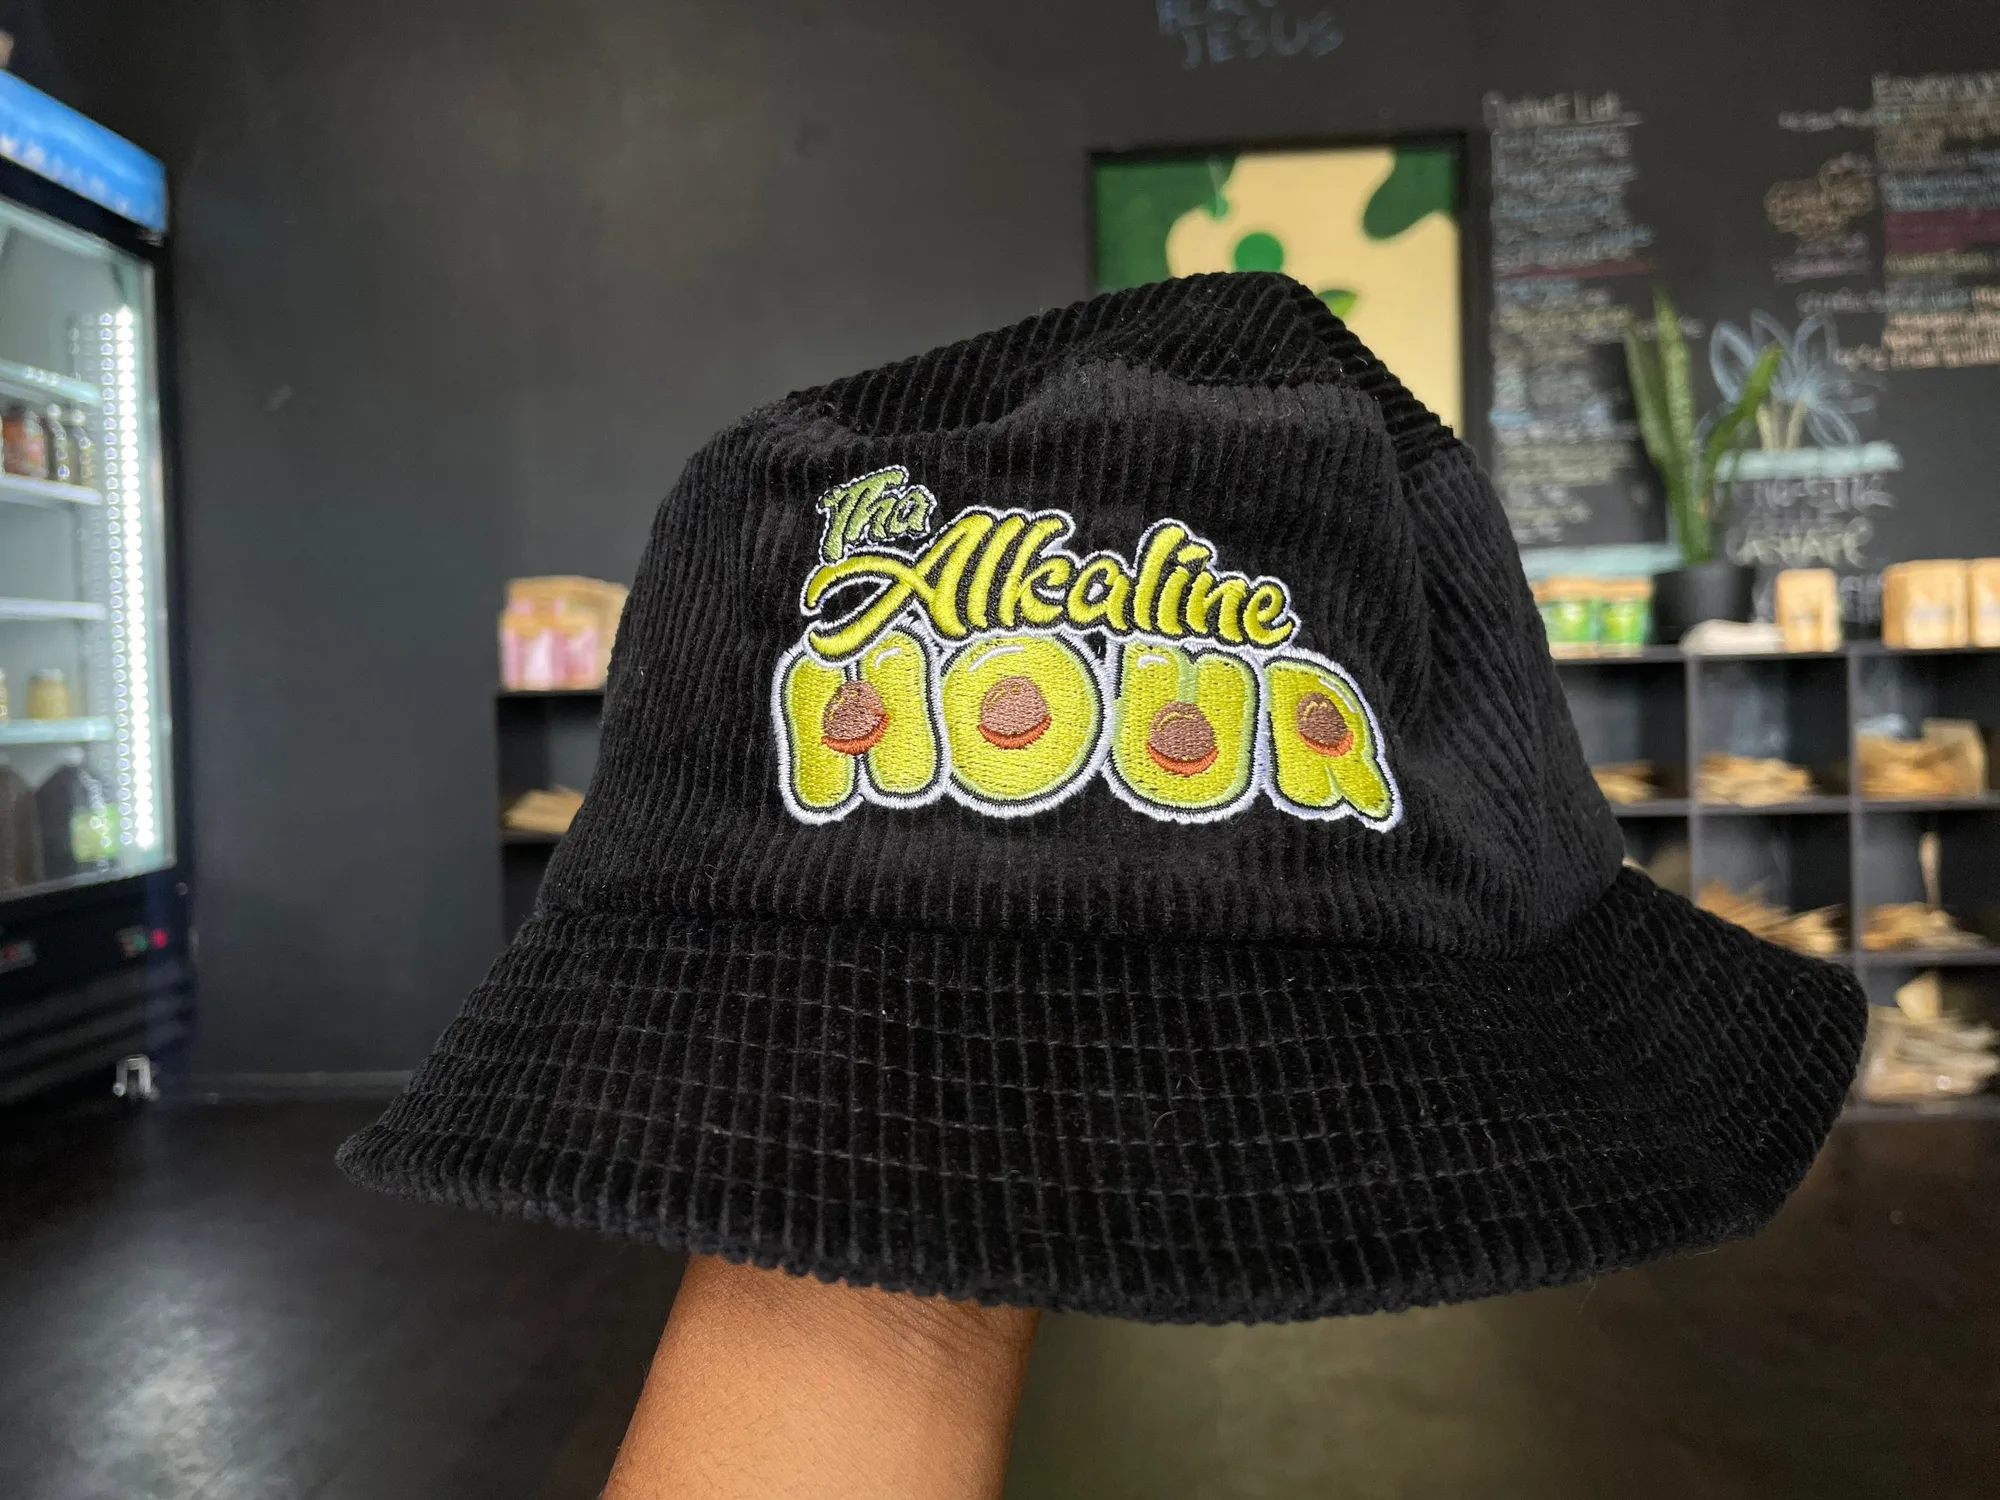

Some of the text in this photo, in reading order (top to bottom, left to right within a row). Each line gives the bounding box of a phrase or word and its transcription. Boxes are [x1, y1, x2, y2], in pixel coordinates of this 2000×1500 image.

[801, 506, 1300, 653] Alkaline
[817, 465, 937, 565] Tha
[772, 630, 1402, 832] HOUR
